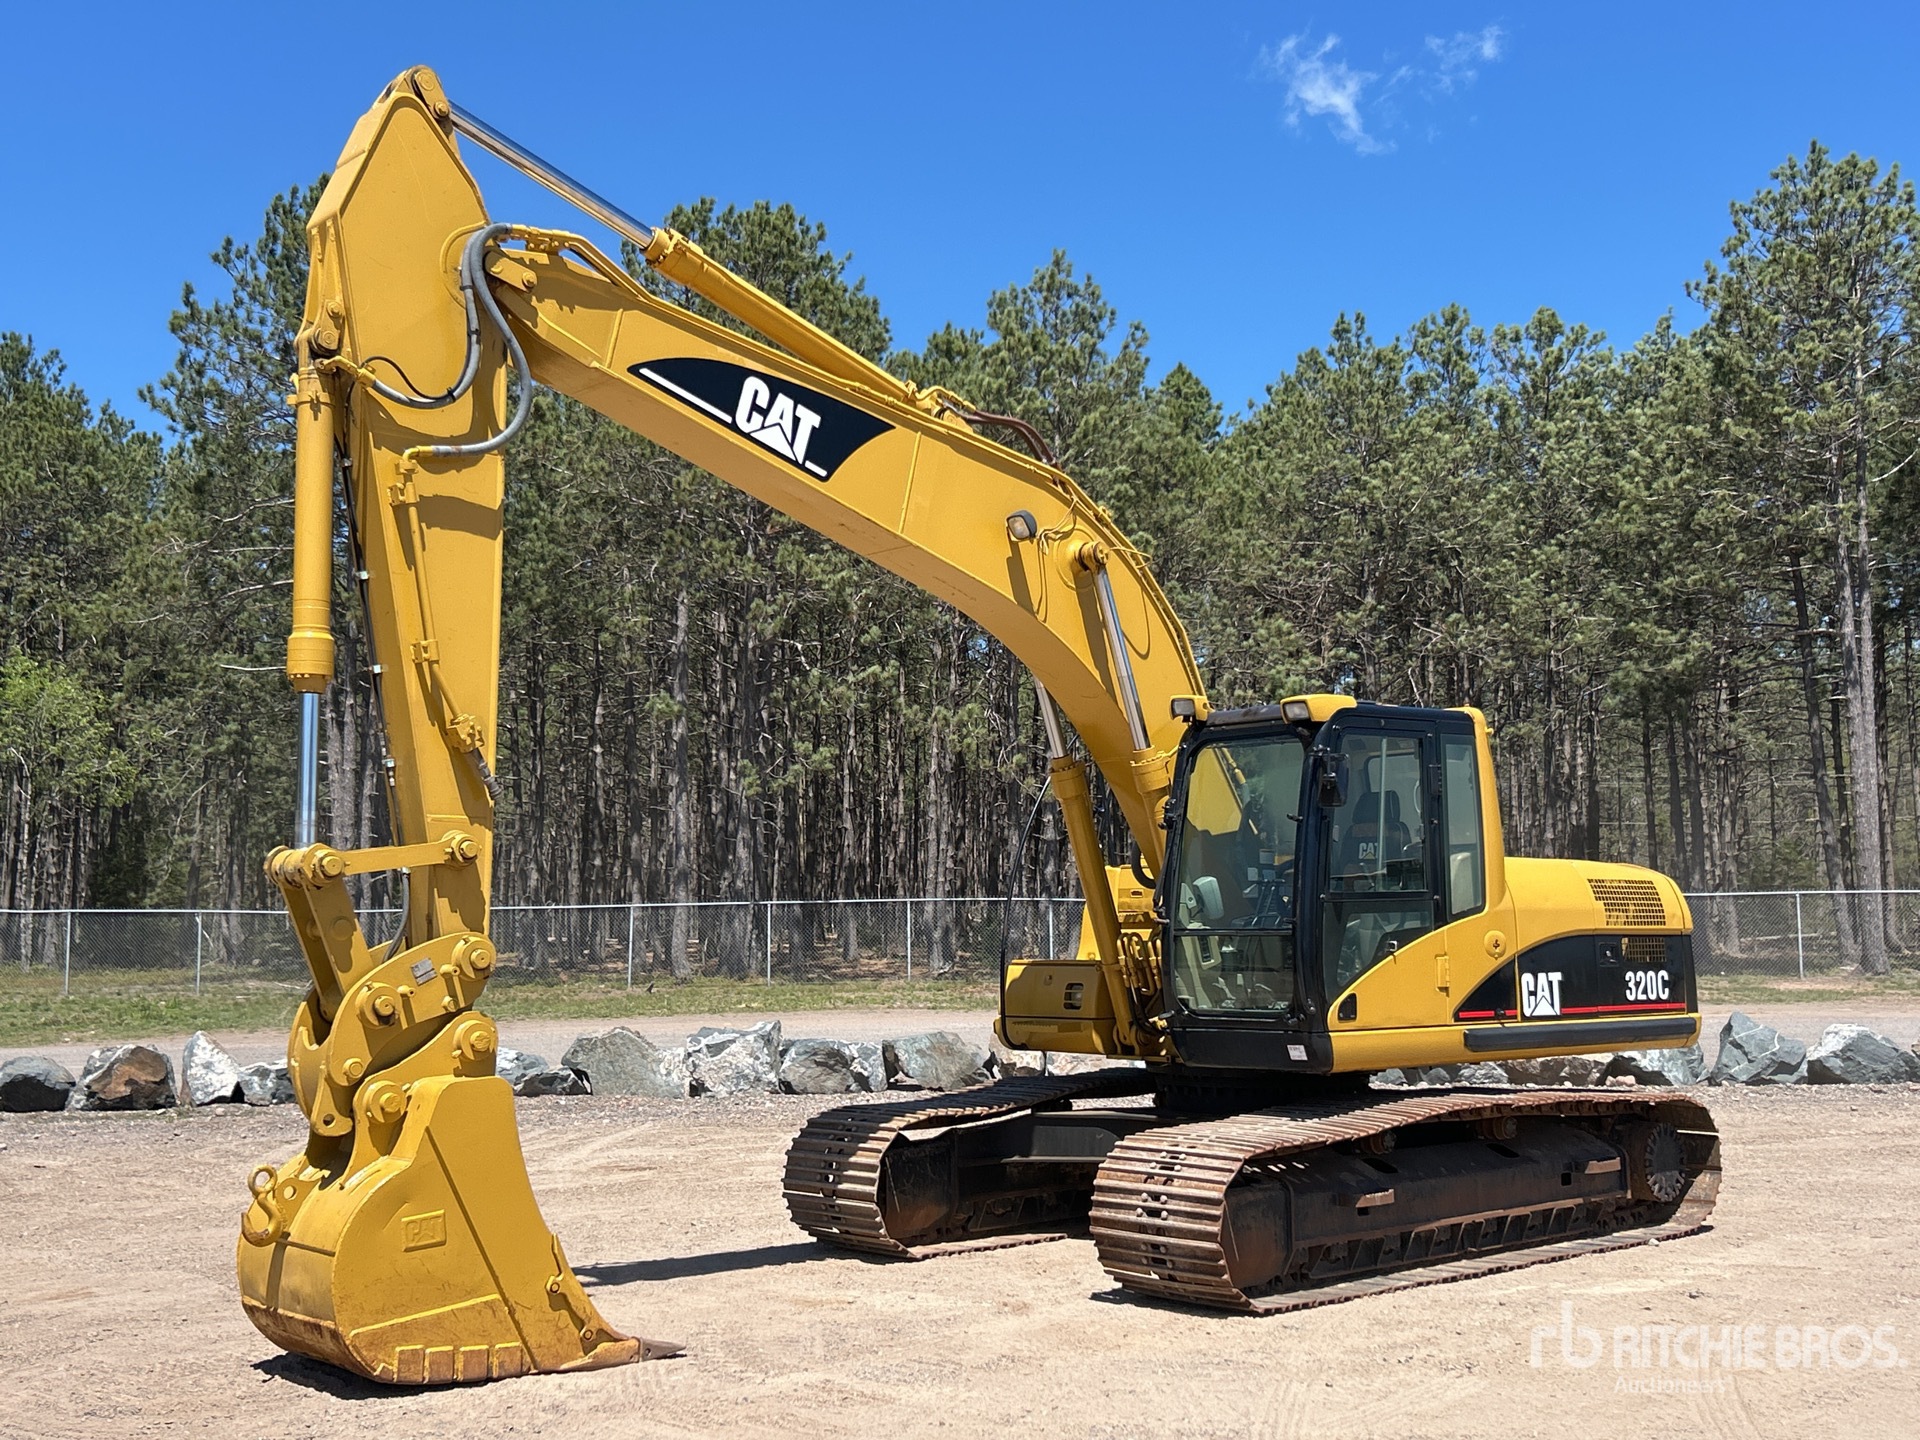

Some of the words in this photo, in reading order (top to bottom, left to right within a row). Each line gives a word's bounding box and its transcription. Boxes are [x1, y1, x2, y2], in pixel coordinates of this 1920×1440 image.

[735, 376, 821, 464] CAT
[1521, 972, 1562, 1017] CAT
[1625, 970, 1669, 1001] 320C
